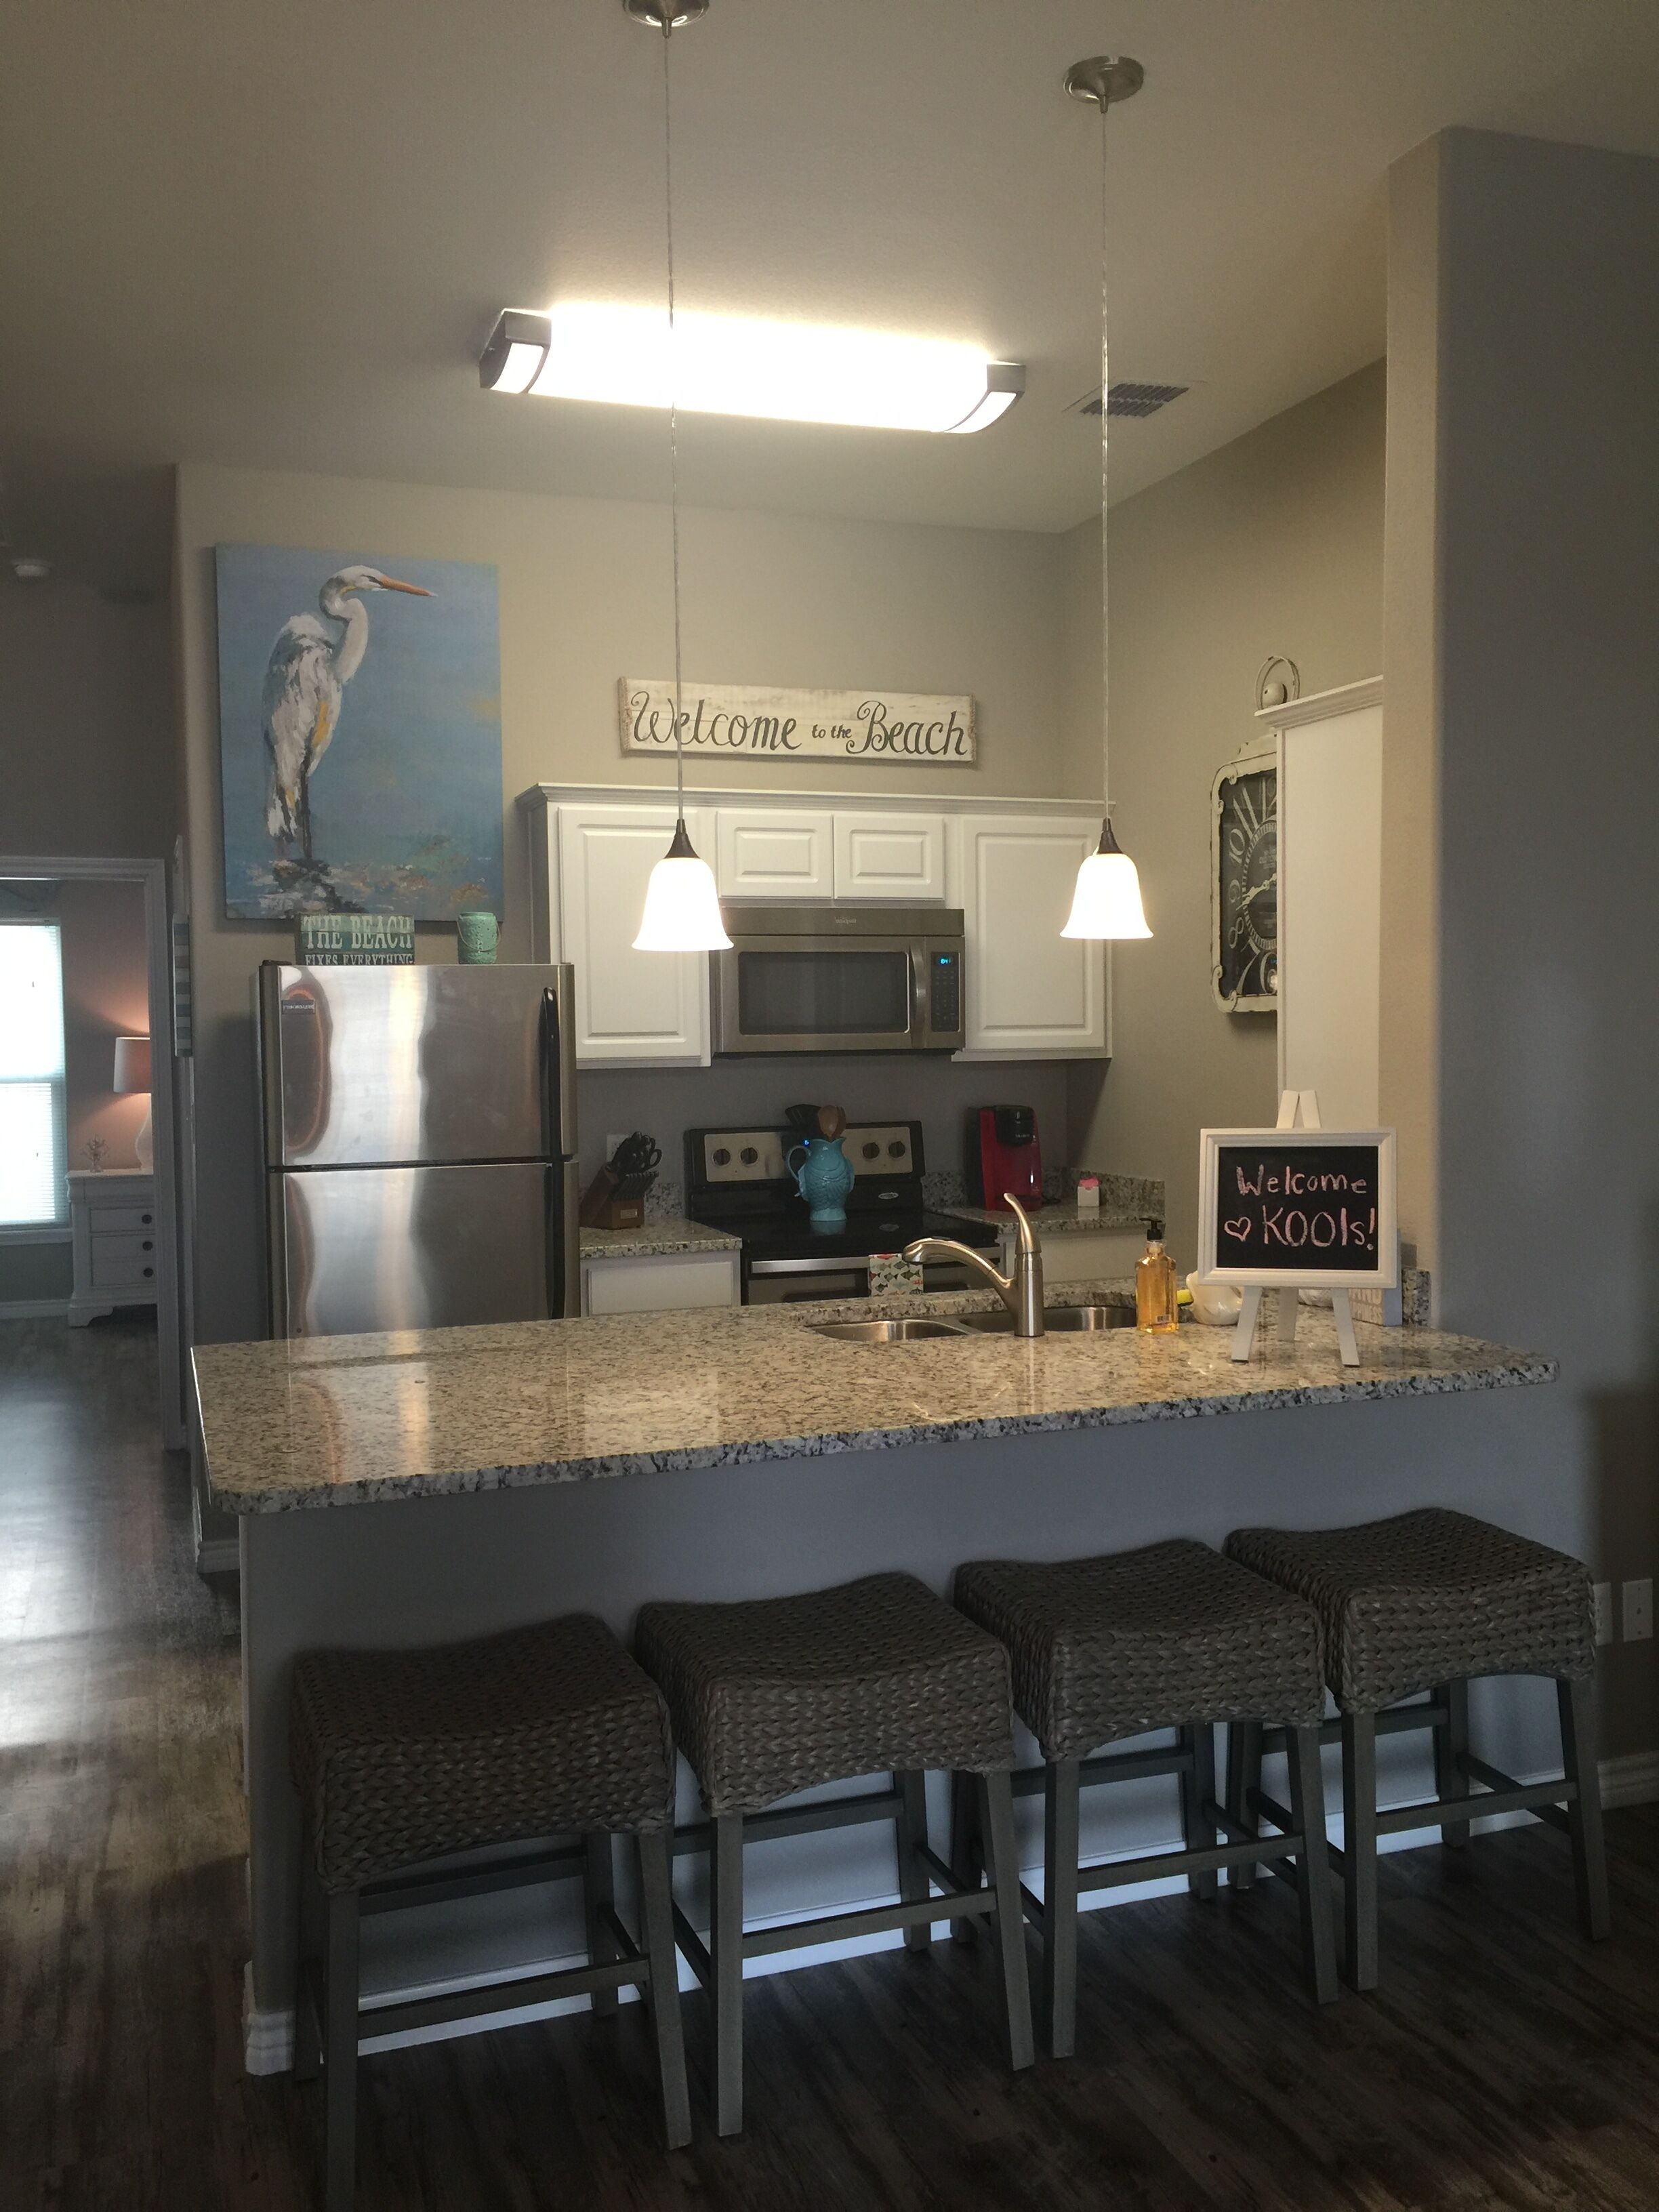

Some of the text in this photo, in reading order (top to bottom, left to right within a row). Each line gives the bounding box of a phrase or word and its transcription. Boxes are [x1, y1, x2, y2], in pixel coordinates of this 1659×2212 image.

[631, 690, 968, 755] Welcome to the Beach
[304, 916, 413, 949] THE BEACH
[1228, 916, 1244, 949] 8
[306, 954, 414, 966] FIXES EVERYTHING
[1236, 1164, 1368, 1196] Welcome
